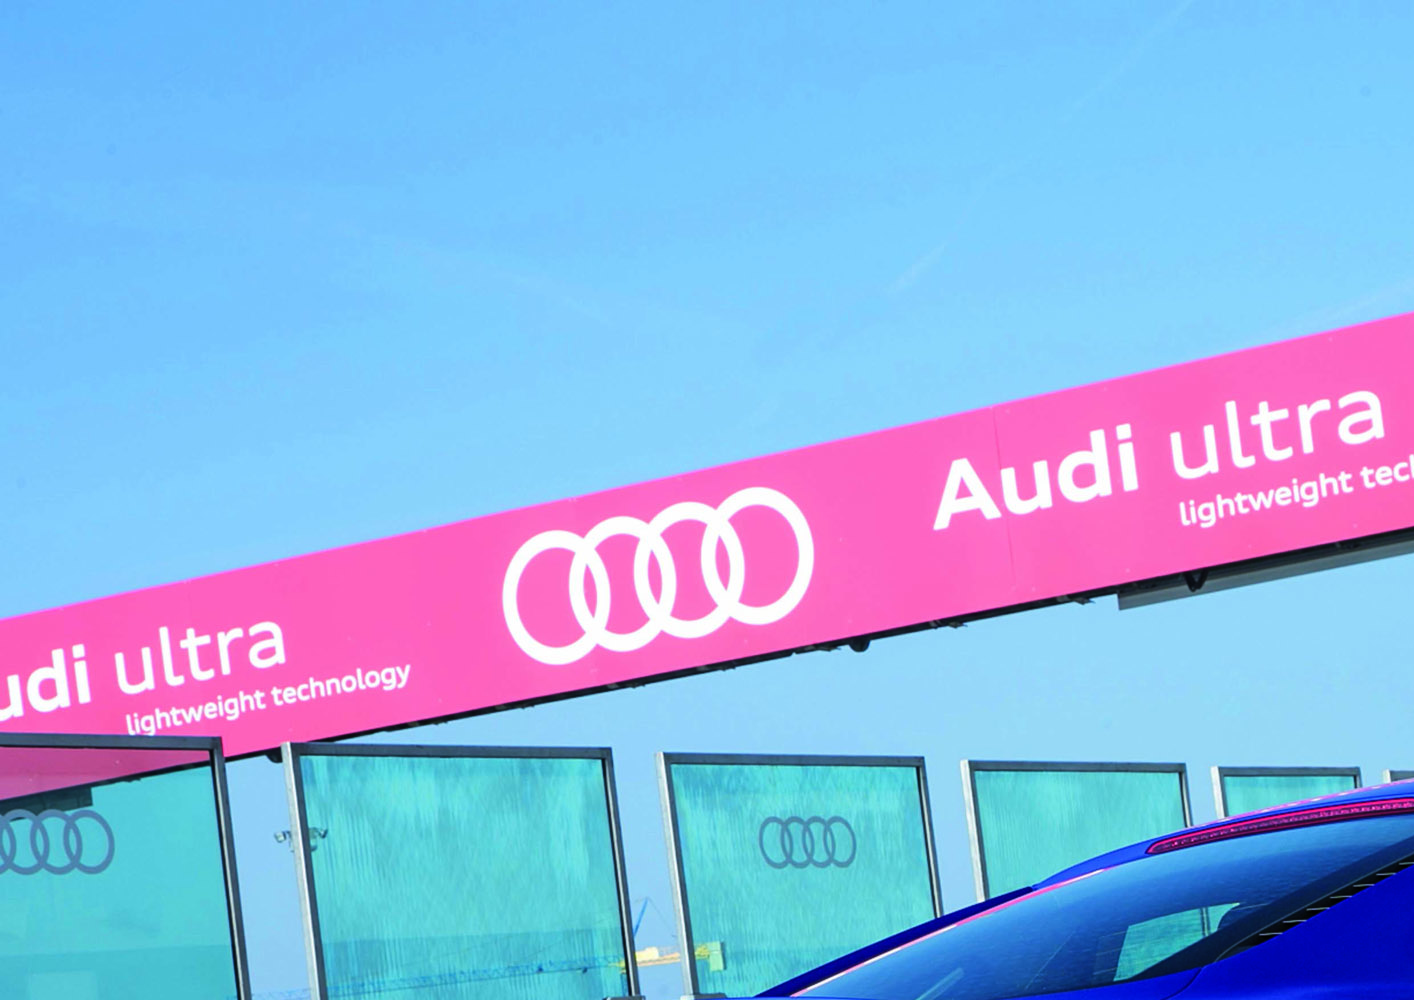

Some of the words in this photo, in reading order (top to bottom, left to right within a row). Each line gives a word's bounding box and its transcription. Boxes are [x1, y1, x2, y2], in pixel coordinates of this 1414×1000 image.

[932, 423, 1139, 530] Audi
[1169, 390, 1385, 480] ultra
[1179, 470, 1354, 528] lightweight
[114, 621, 286, 695] ultra
[126, 689, 266, 736] lightweight
[271, 663, 411, 706] technology
